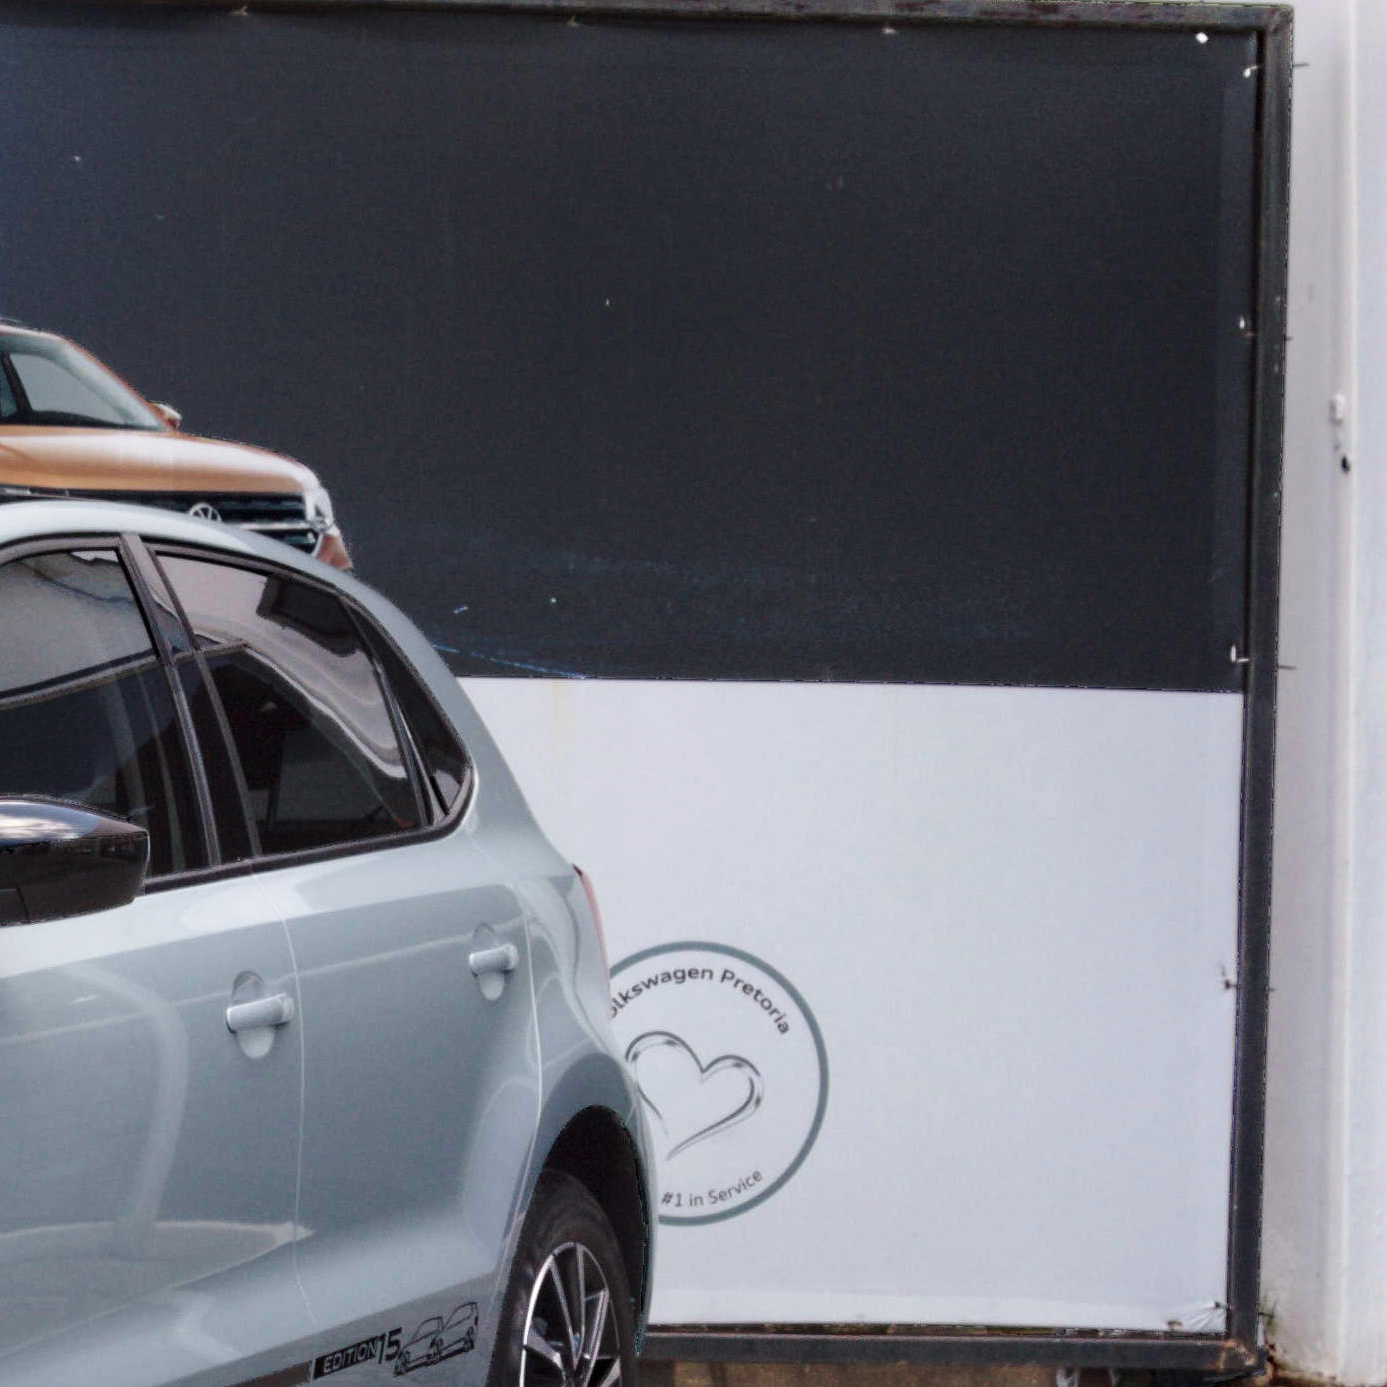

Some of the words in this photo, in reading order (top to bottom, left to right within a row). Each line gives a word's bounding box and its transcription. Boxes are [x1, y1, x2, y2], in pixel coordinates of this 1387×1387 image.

[611, 967, 714, 1018] lkswagen
[720, 968, 790, 1035] Pretoria
[661, 1191, 683, 1207] #1
[689, 1193, 704, 1207] in
[708, 1170, 763, 1204] Service
